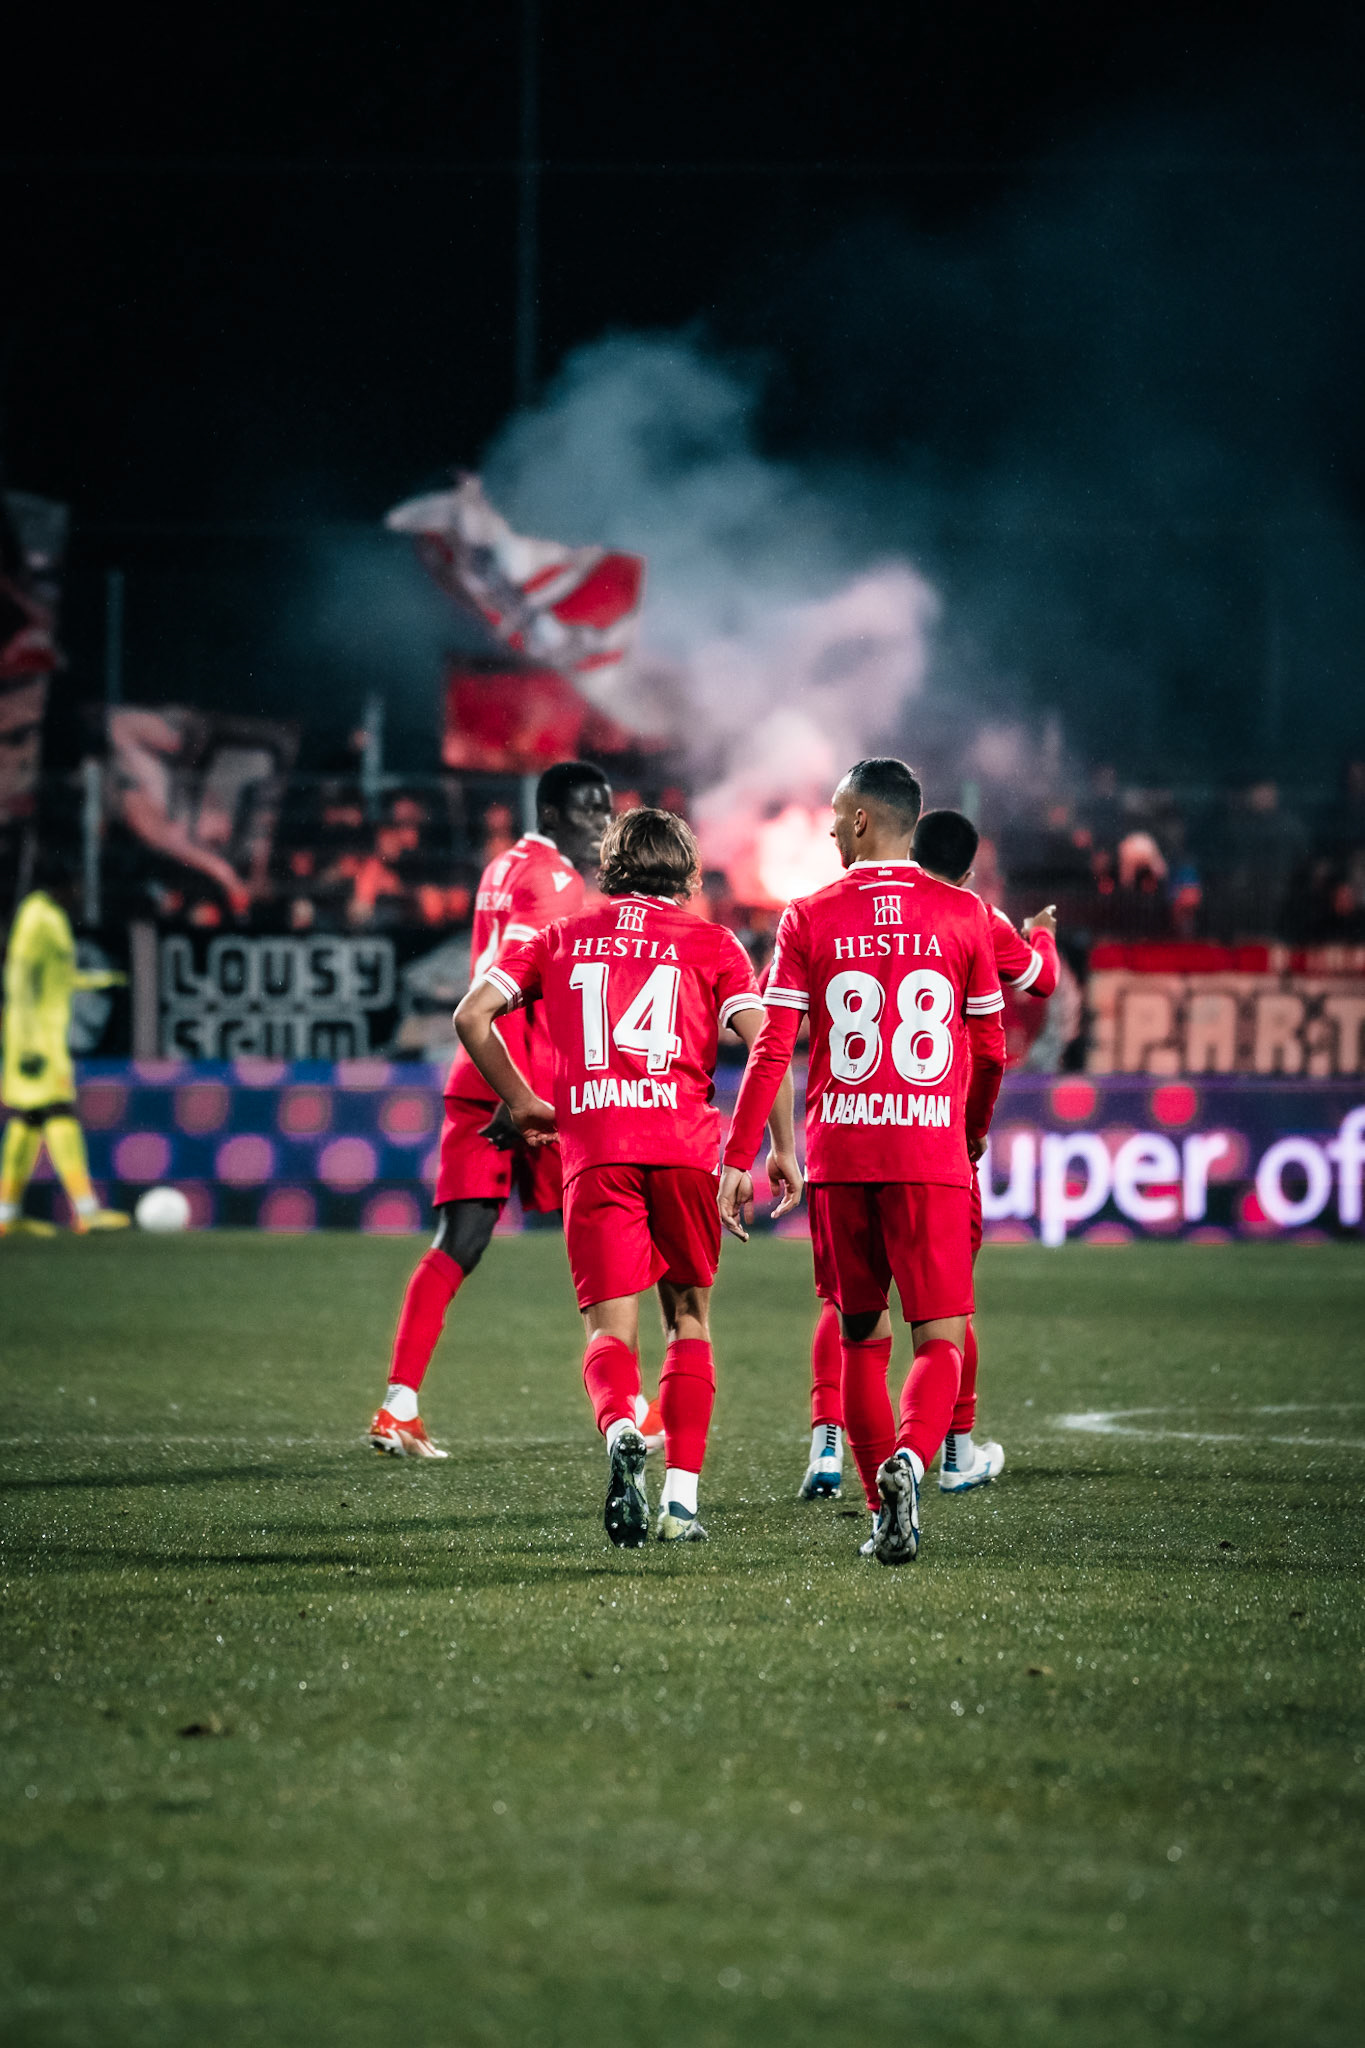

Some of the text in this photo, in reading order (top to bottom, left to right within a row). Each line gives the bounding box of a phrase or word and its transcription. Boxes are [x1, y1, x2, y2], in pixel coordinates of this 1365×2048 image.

[571, 937, 679, 961] HESTIA
[834, 933, 943, 960] HESTIA
[569, 962, 682, 1076] 14
[825, 969, 955, 1087] 88
[570, 1078, 678, 1115] LAVANCHY
[819, 1092, 951, 1128] KABACALMAN
